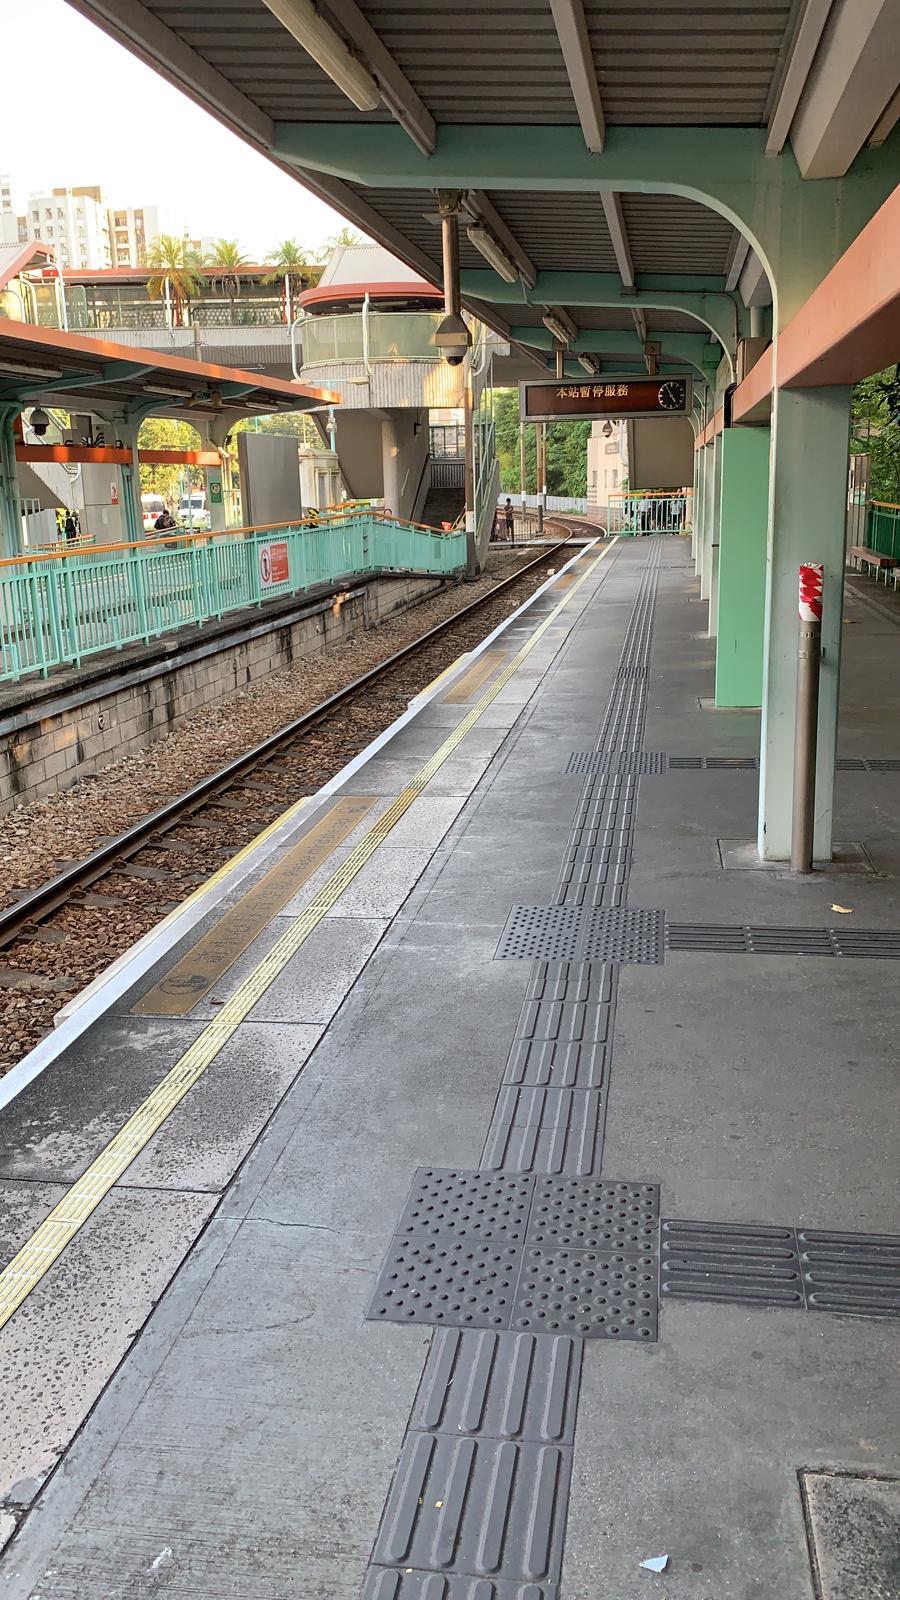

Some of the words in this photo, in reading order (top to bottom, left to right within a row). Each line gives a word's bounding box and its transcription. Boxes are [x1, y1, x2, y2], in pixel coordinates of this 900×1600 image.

[556, 384, 629, 398] 本站暫停服務
